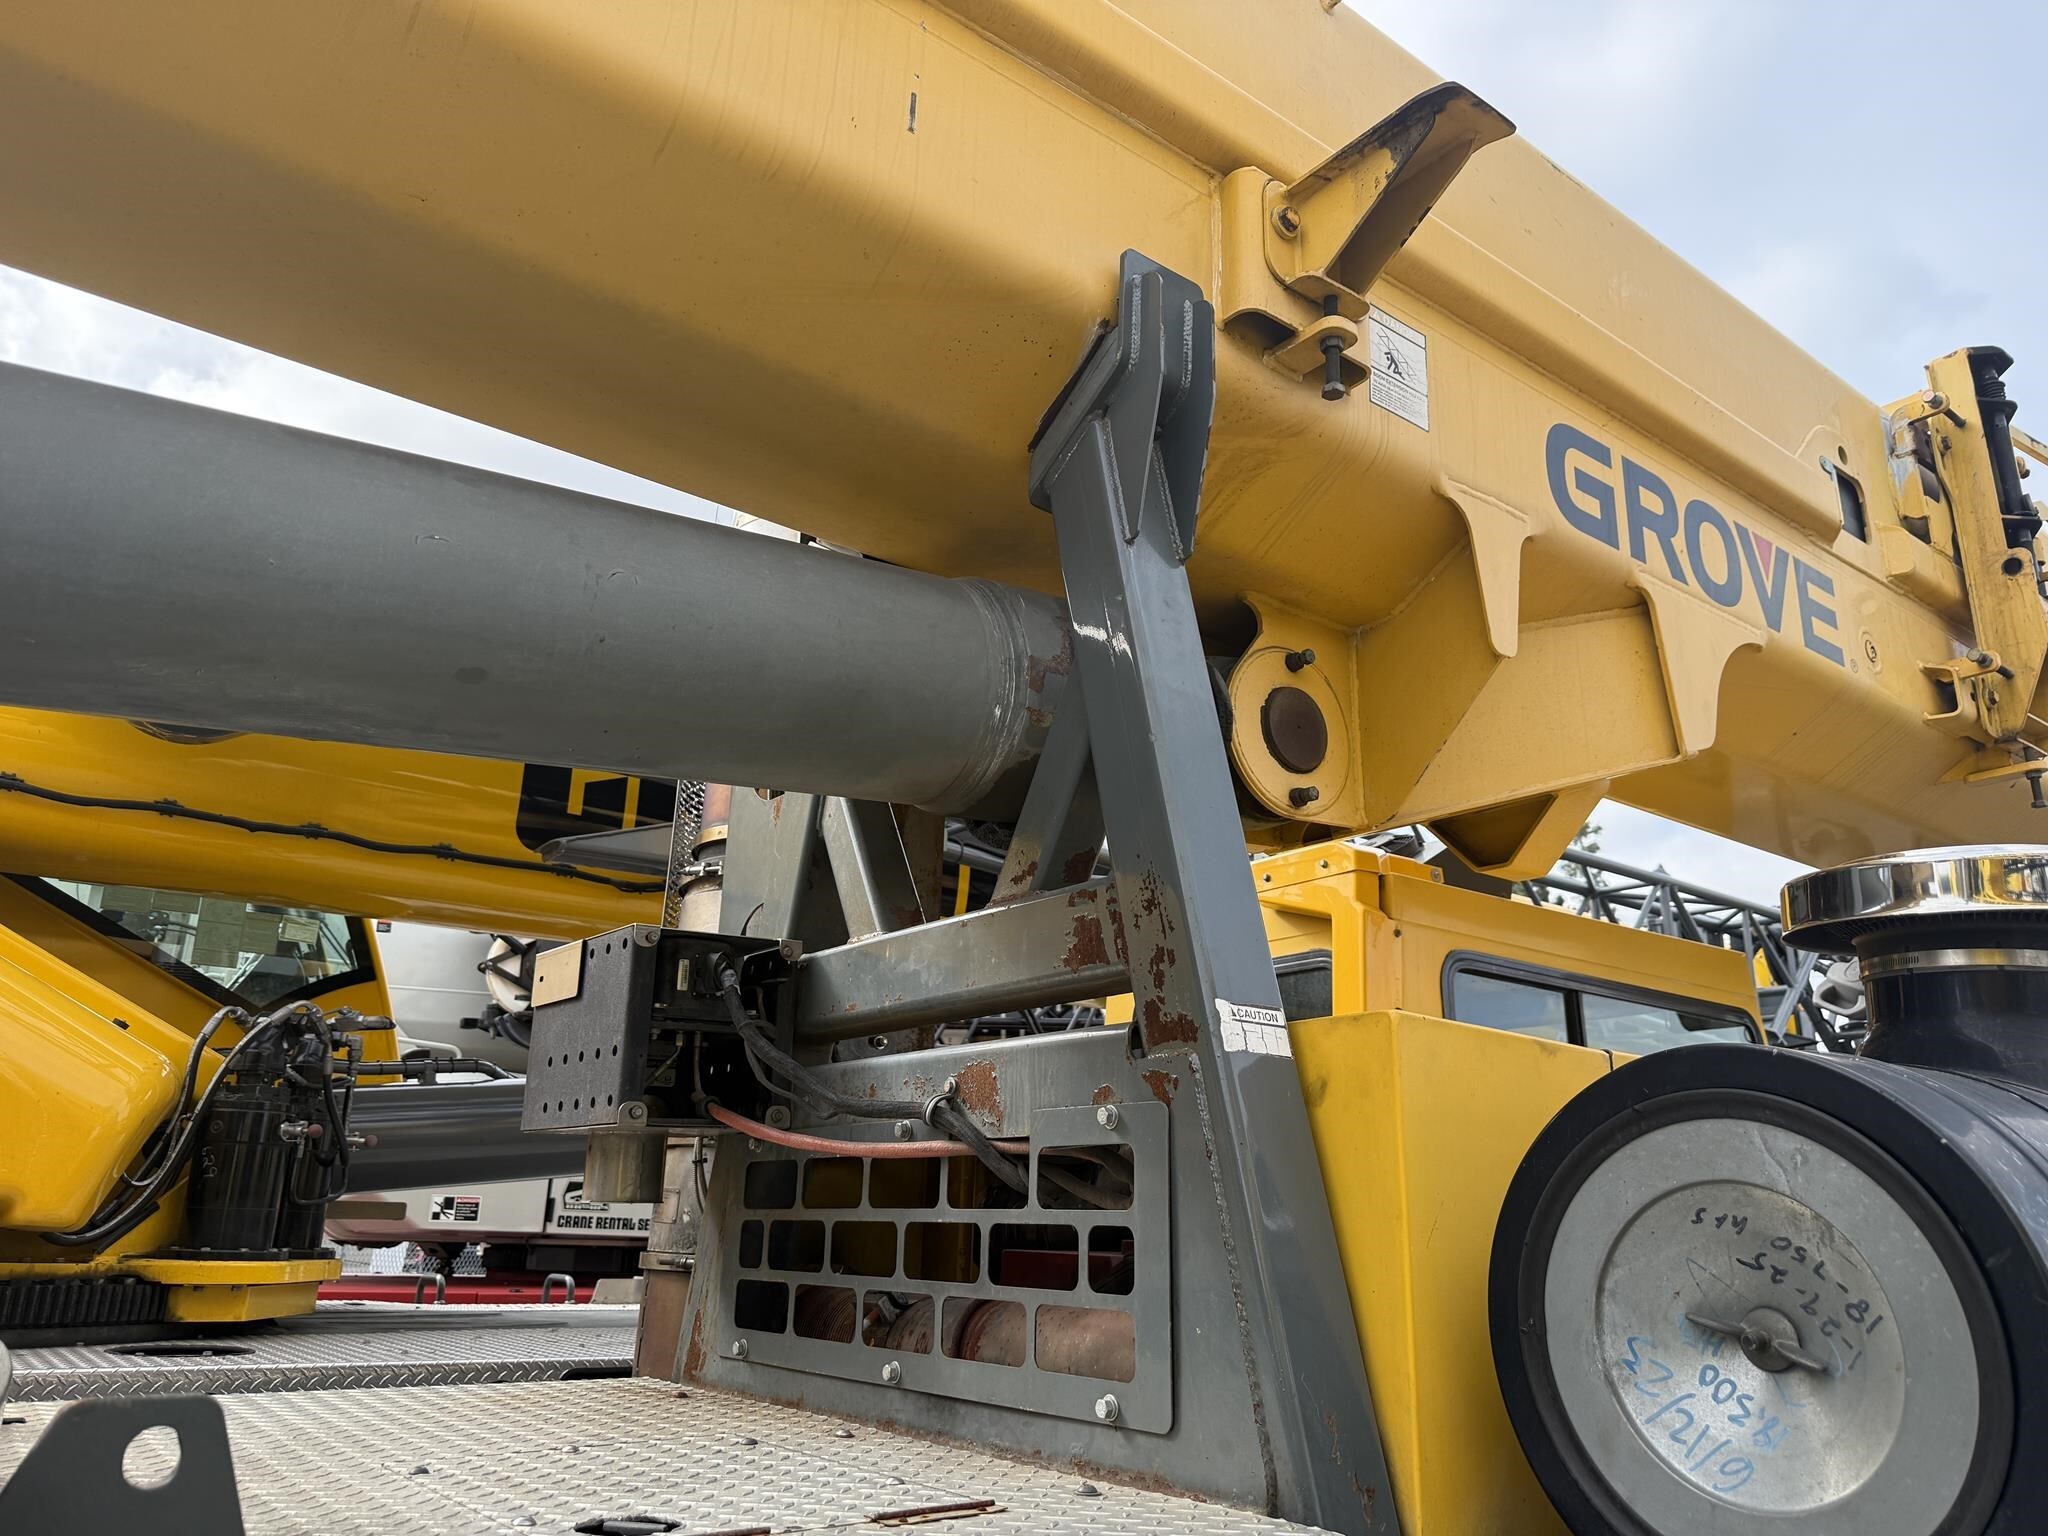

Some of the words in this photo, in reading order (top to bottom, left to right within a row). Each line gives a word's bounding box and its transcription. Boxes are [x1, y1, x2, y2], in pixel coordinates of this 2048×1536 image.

[1545, 422, 1845, 667] GROVE
[1237, 1008, 1279, 1023] CAUTION
[557, 1215, 594, 1229] CRANE
[595, 1216, 636, 1231] RENTAL
